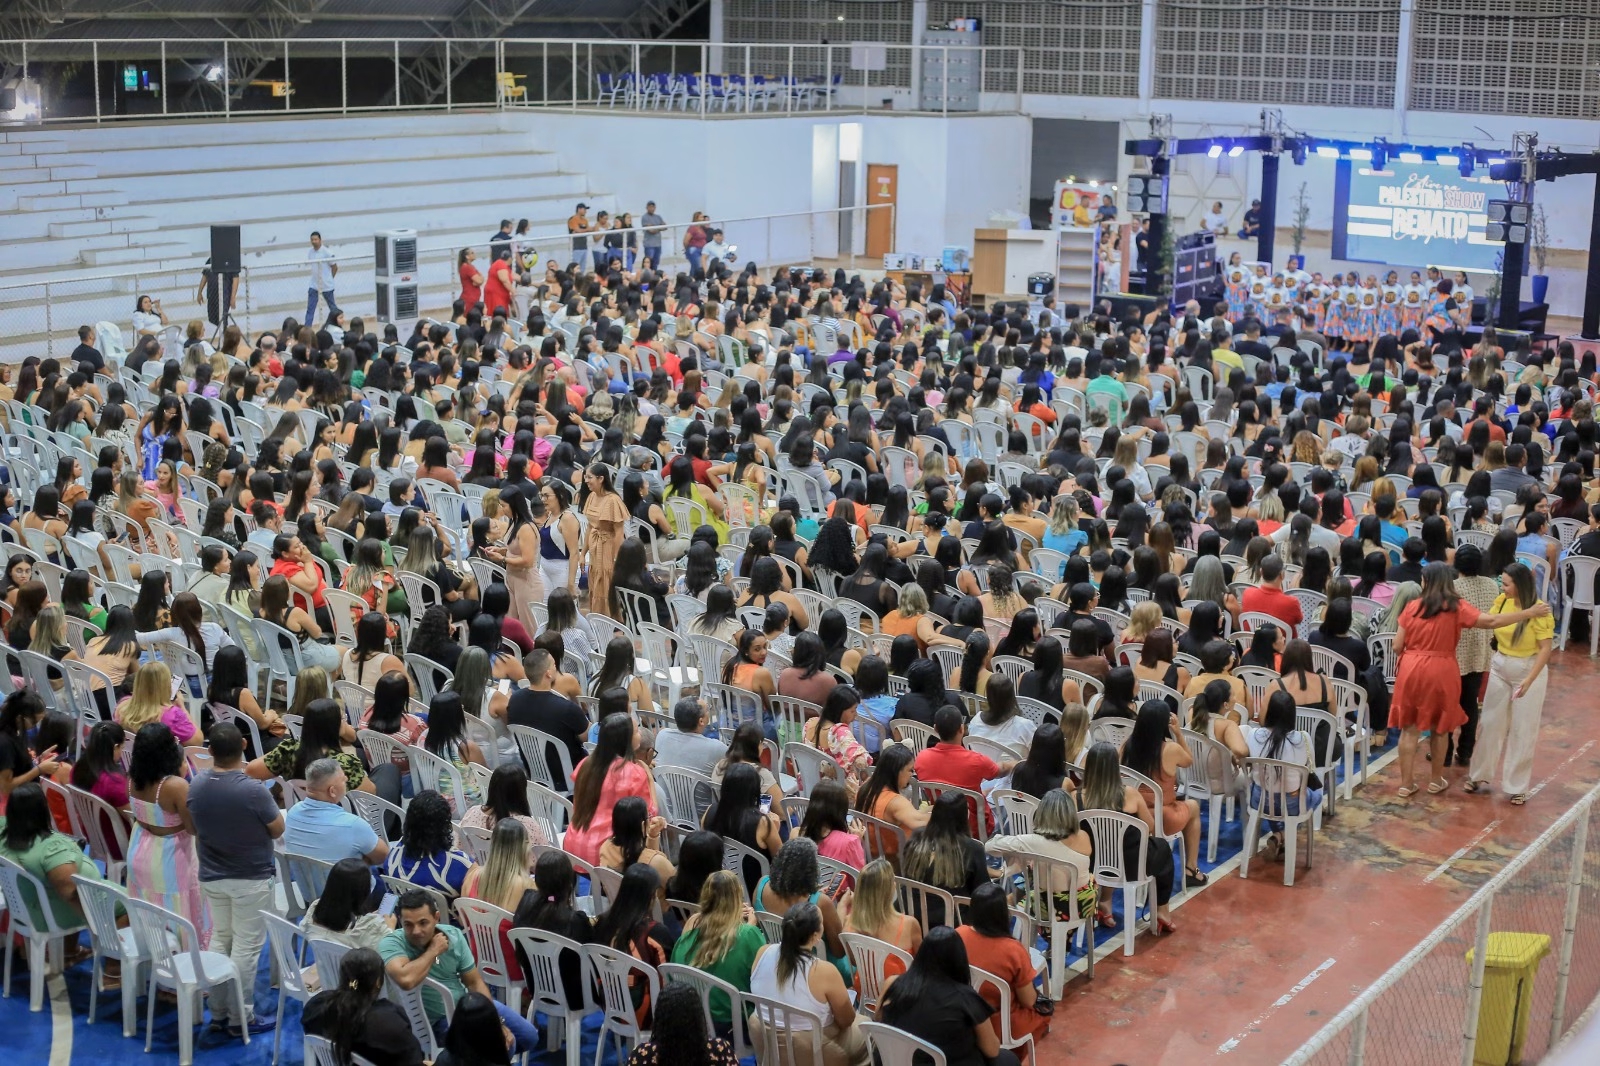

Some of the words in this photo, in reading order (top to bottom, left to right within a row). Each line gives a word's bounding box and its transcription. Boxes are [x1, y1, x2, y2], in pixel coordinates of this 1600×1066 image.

[1379, 186, 1443, 209] PALESTRA
[1443, 191, 1485, 210] SHOW
[1392, 208, 1469, 239] RENATO
